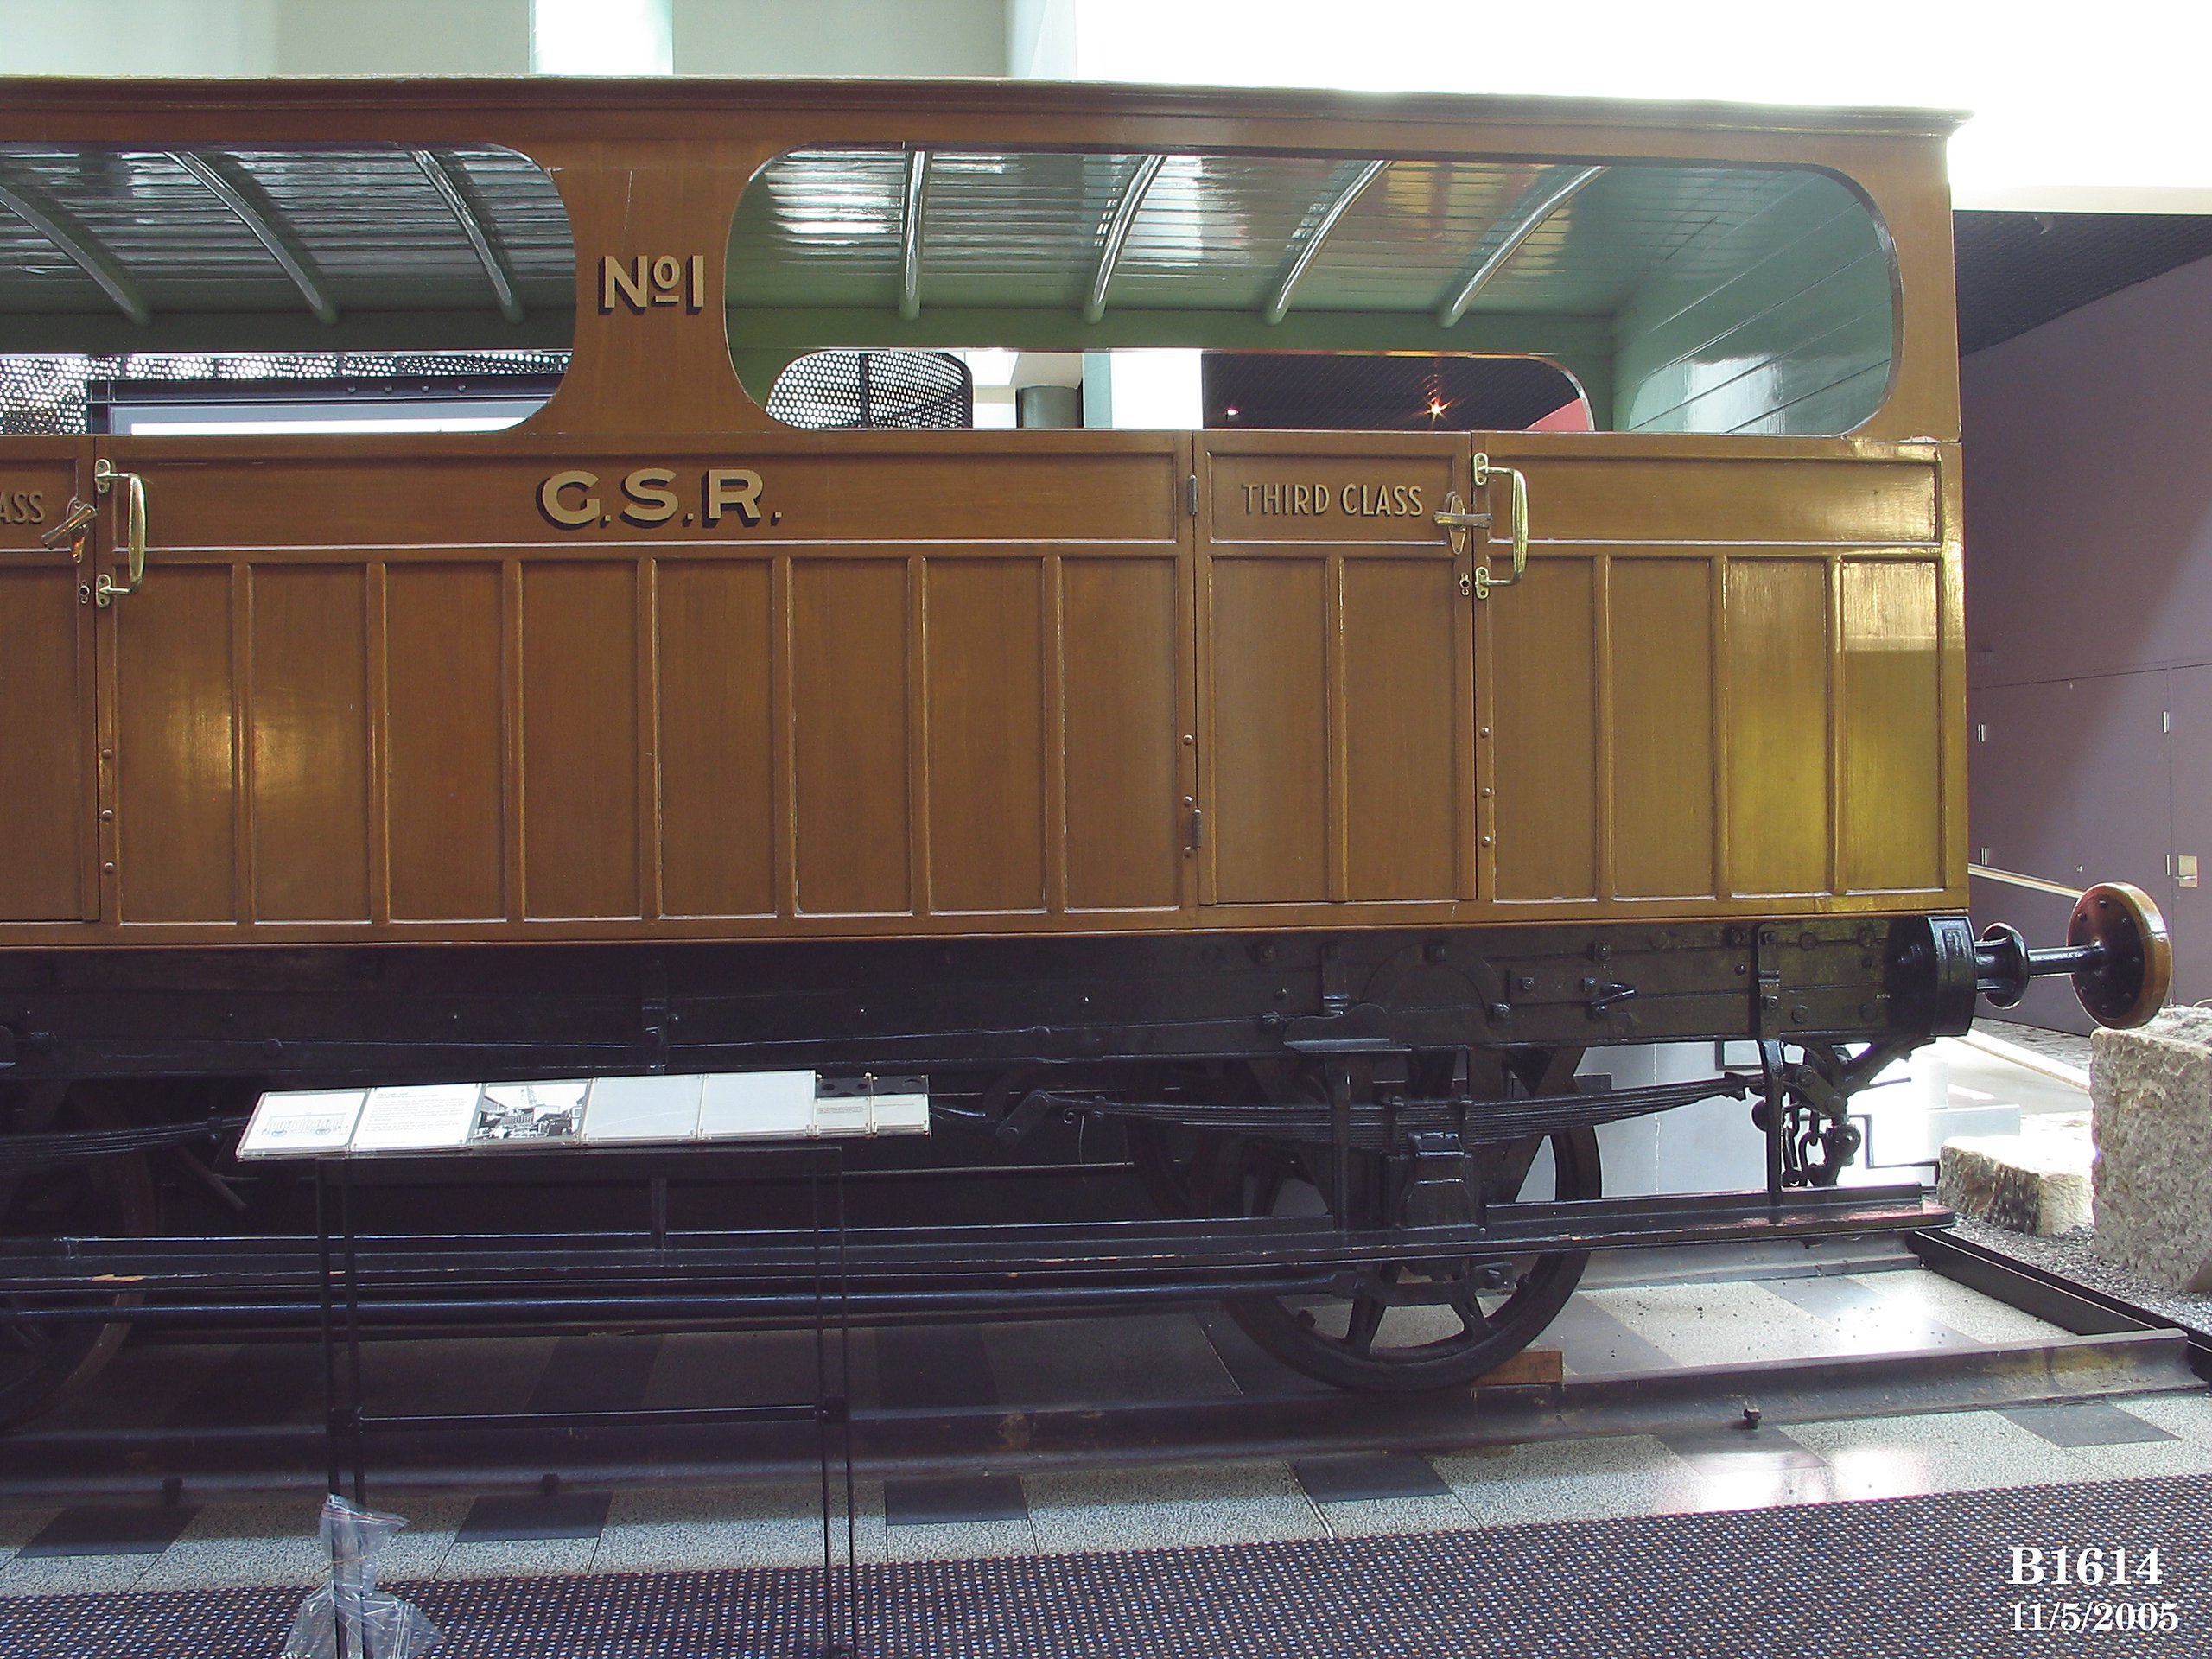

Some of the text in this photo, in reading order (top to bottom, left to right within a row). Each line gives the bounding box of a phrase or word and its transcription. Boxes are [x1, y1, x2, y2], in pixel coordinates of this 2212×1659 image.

[537, 467, 783, 529] G.S.R.
[1242, 482, 1425, 517] THIRD CLASS
